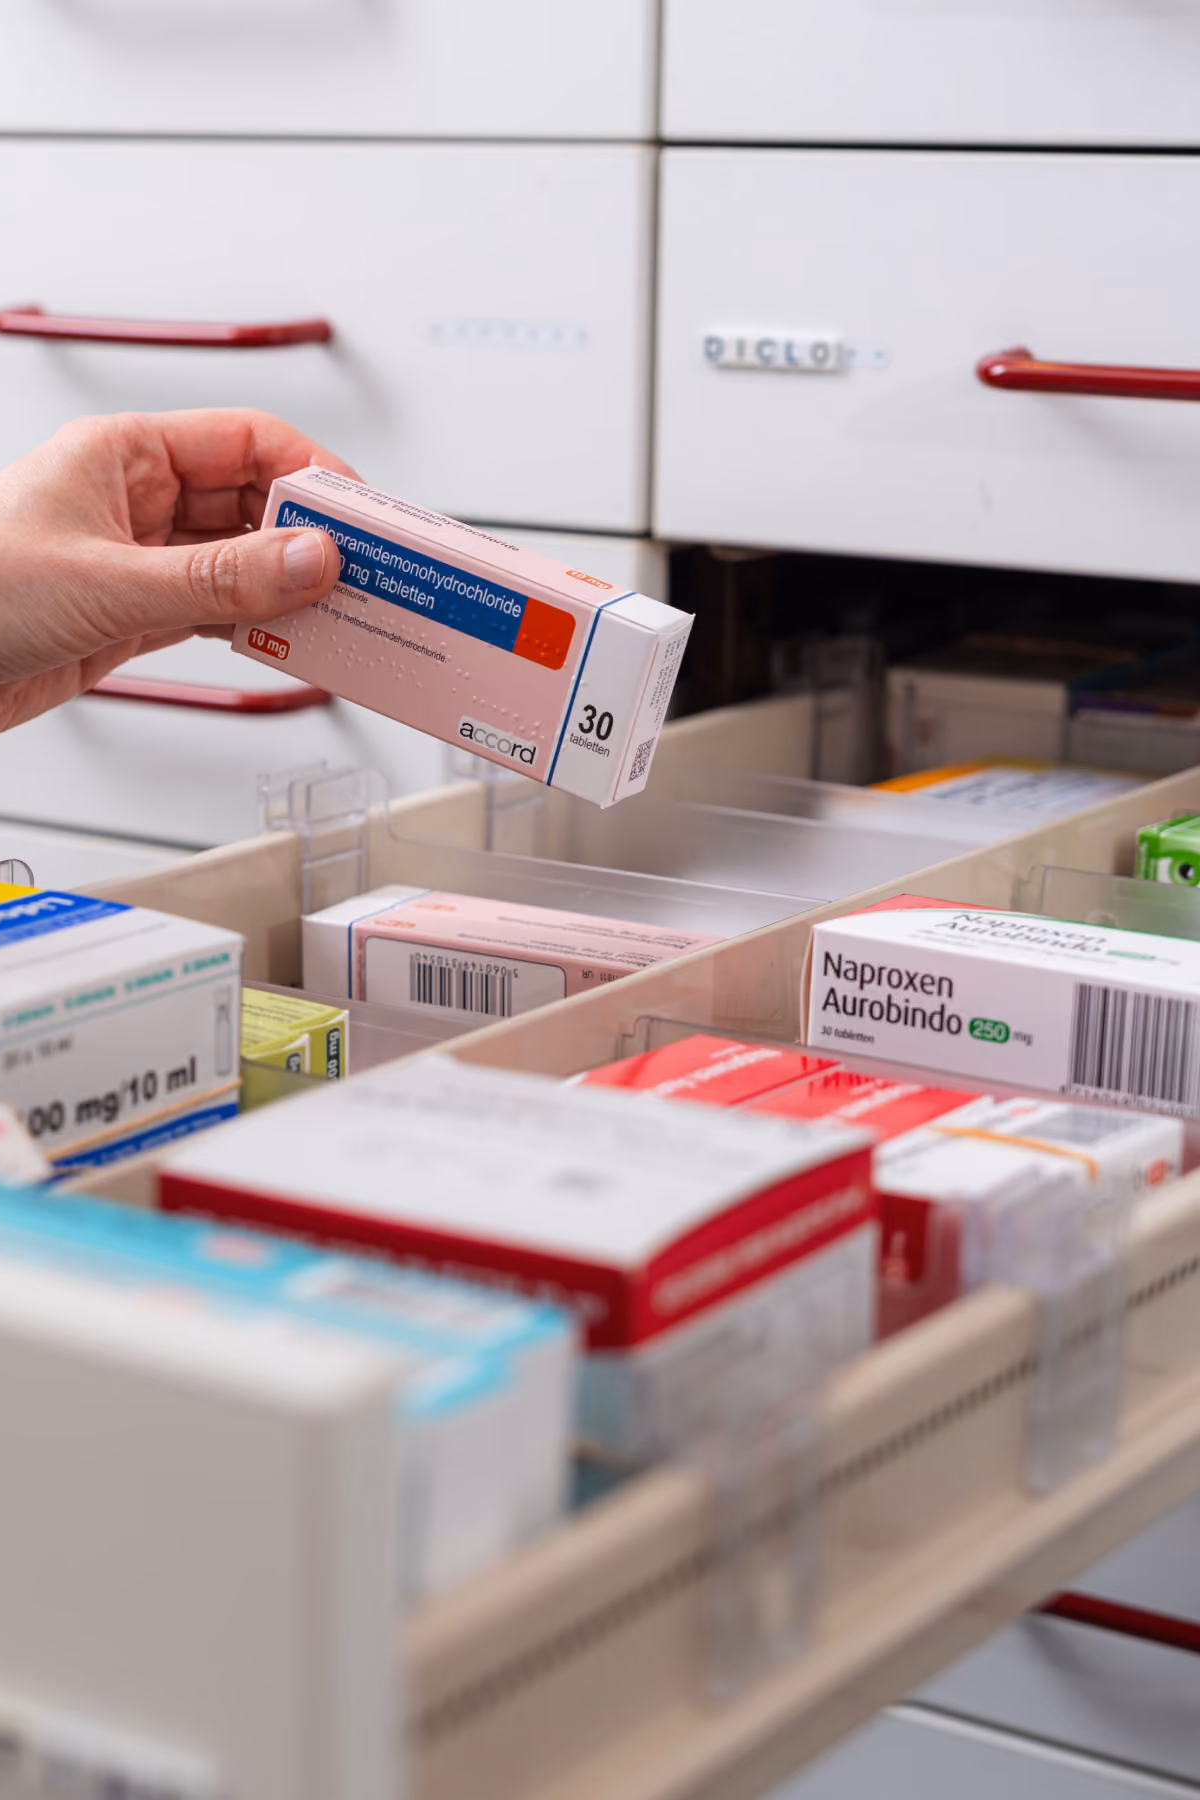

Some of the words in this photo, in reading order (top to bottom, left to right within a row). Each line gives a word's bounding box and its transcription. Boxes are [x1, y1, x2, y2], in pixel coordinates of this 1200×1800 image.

[704, 334, 830, 366] DICLO
[308, 473, 352, 491] Accord
[356, 490, 369, 499] 10
[369, 495, 388, 506] mg
[391, 504, 443, 528] Tabletten
[347, 562, 370, 585] mg
[375, 571, 435, 611] Tabletten
[250, 630, 266, 647] 10
[267, 639, 288, 659] mg
[578, 704, 614, 741] 30
[459, 721, 537, 765] accord
[569, 733, 611, 758] tabletten
[935, 921, 1103, 952] Aurobindo
[953, 913, 1107, 944] Naproxen
[823, 951, 954, 998] Naproxen
[822, 986, 962, 1035] Aurobindo
[972, 1018, 1007, 1042] 250
[1013, 1030, 1033, 1047] mg
[329, 1031, 340, 1056] mg
[820, 1025, 833, 1036] 30
[834, 1027, 875, 1044] tabletten
[20, 1101, 65, 1138] 00
[166, 1056, 197, 1093] ml
